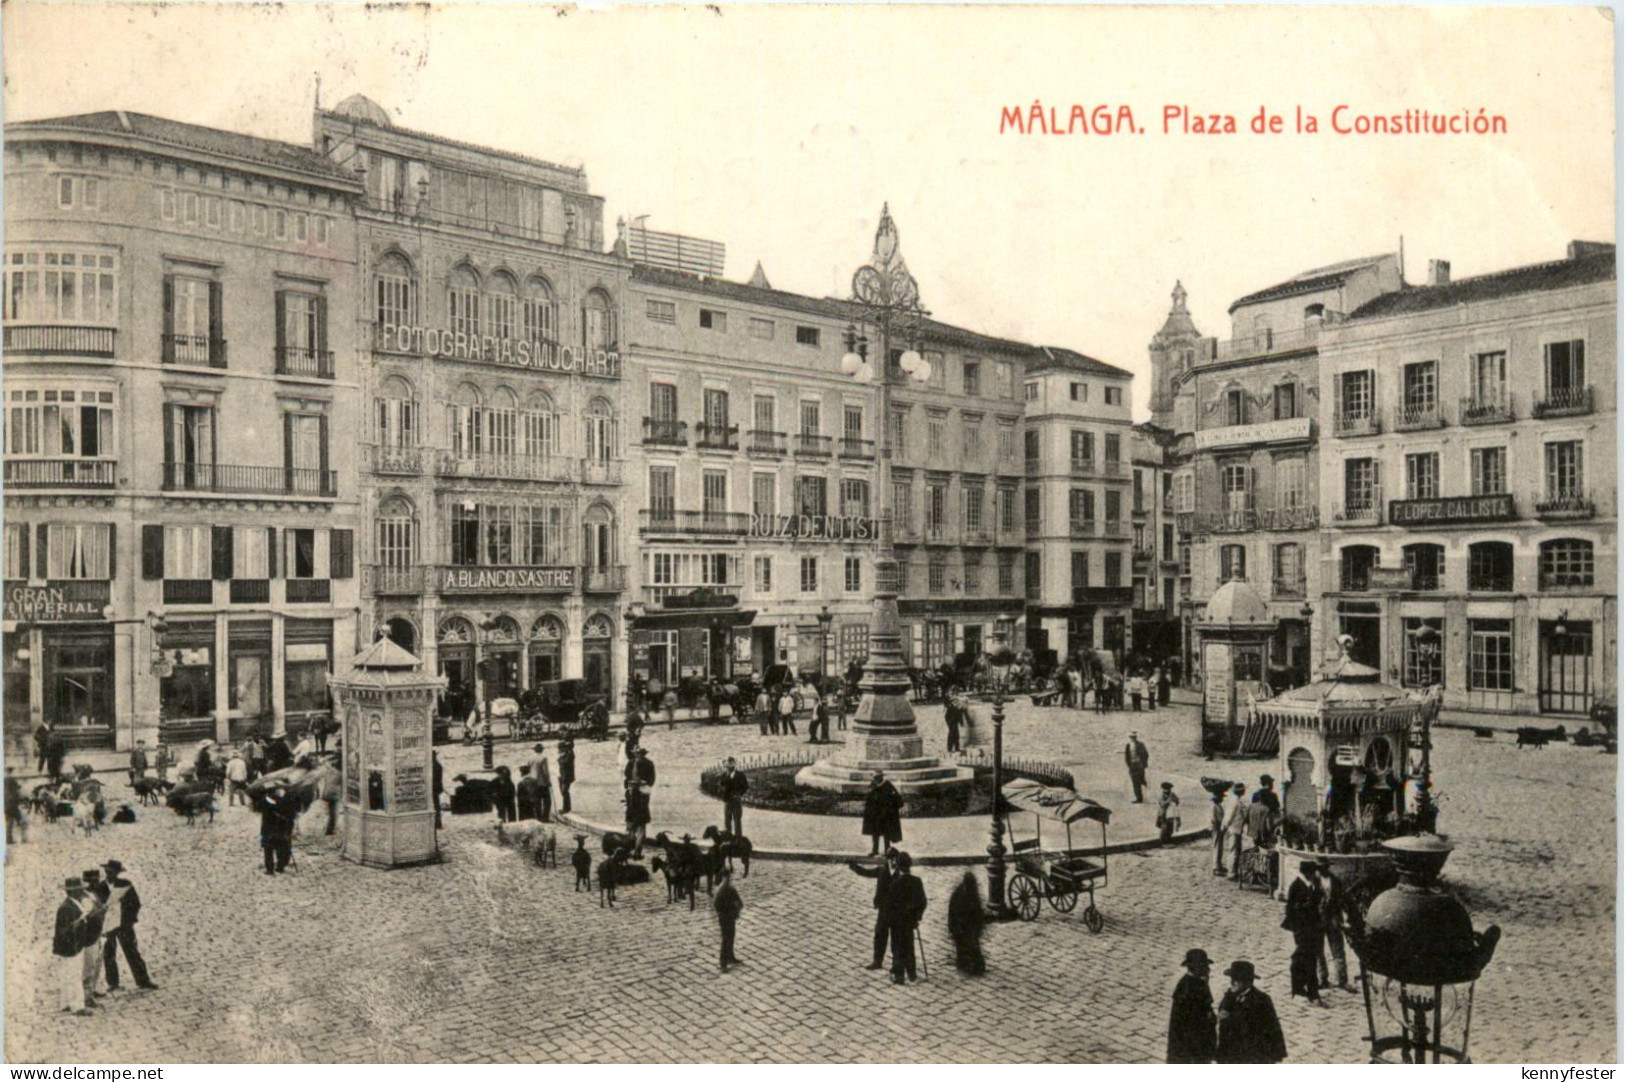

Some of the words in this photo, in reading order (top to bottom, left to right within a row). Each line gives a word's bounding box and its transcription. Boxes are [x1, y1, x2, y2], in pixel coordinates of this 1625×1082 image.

[1447, 499, 1507, 518] CALLISTA
[13, 588, 64, 605] GRAN
[18, 602, 99, 614] IMPERIAL
